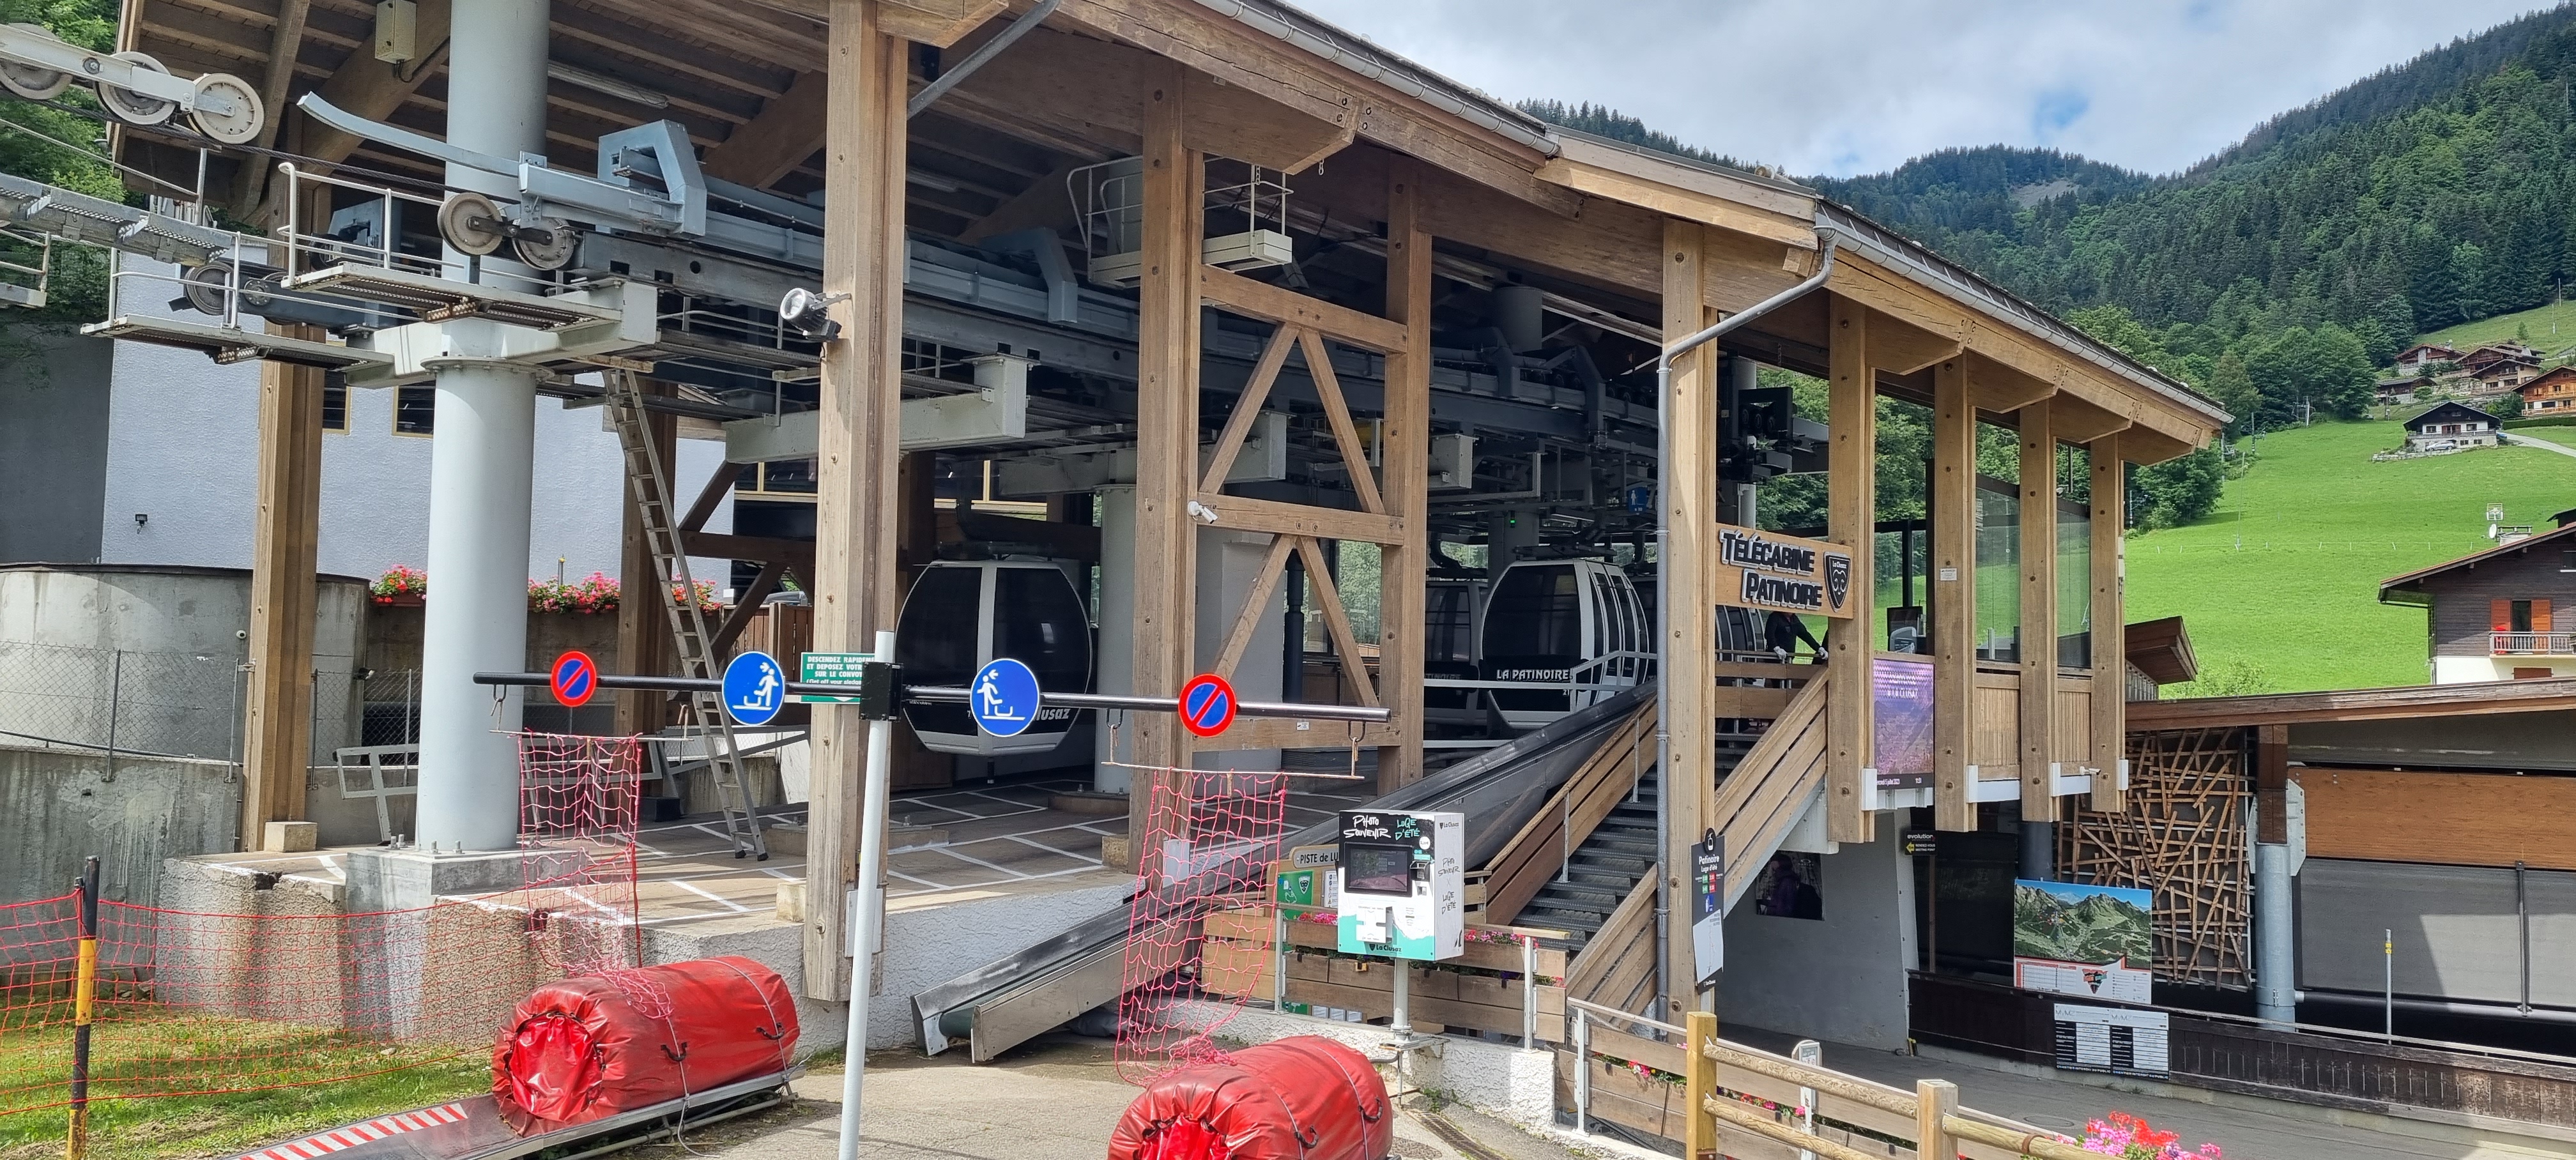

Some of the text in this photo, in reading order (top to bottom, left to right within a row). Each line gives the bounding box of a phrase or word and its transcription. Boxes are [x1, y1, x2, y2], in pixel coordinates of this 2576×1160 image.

[1721, 530, 1815, 575] TÉLÉCABINE
[1744, 570, 1823, 609] PATINOIRE
[1497, 669, 1569, 680] LA PATINOIRE
[1343, 828, 1392, 839] SOUVENIR
[1300, 853, 1317, 864] PISTE
[1319, 853, 1328, 862] de
[1699, 854, 1720, 865] Patinoire
